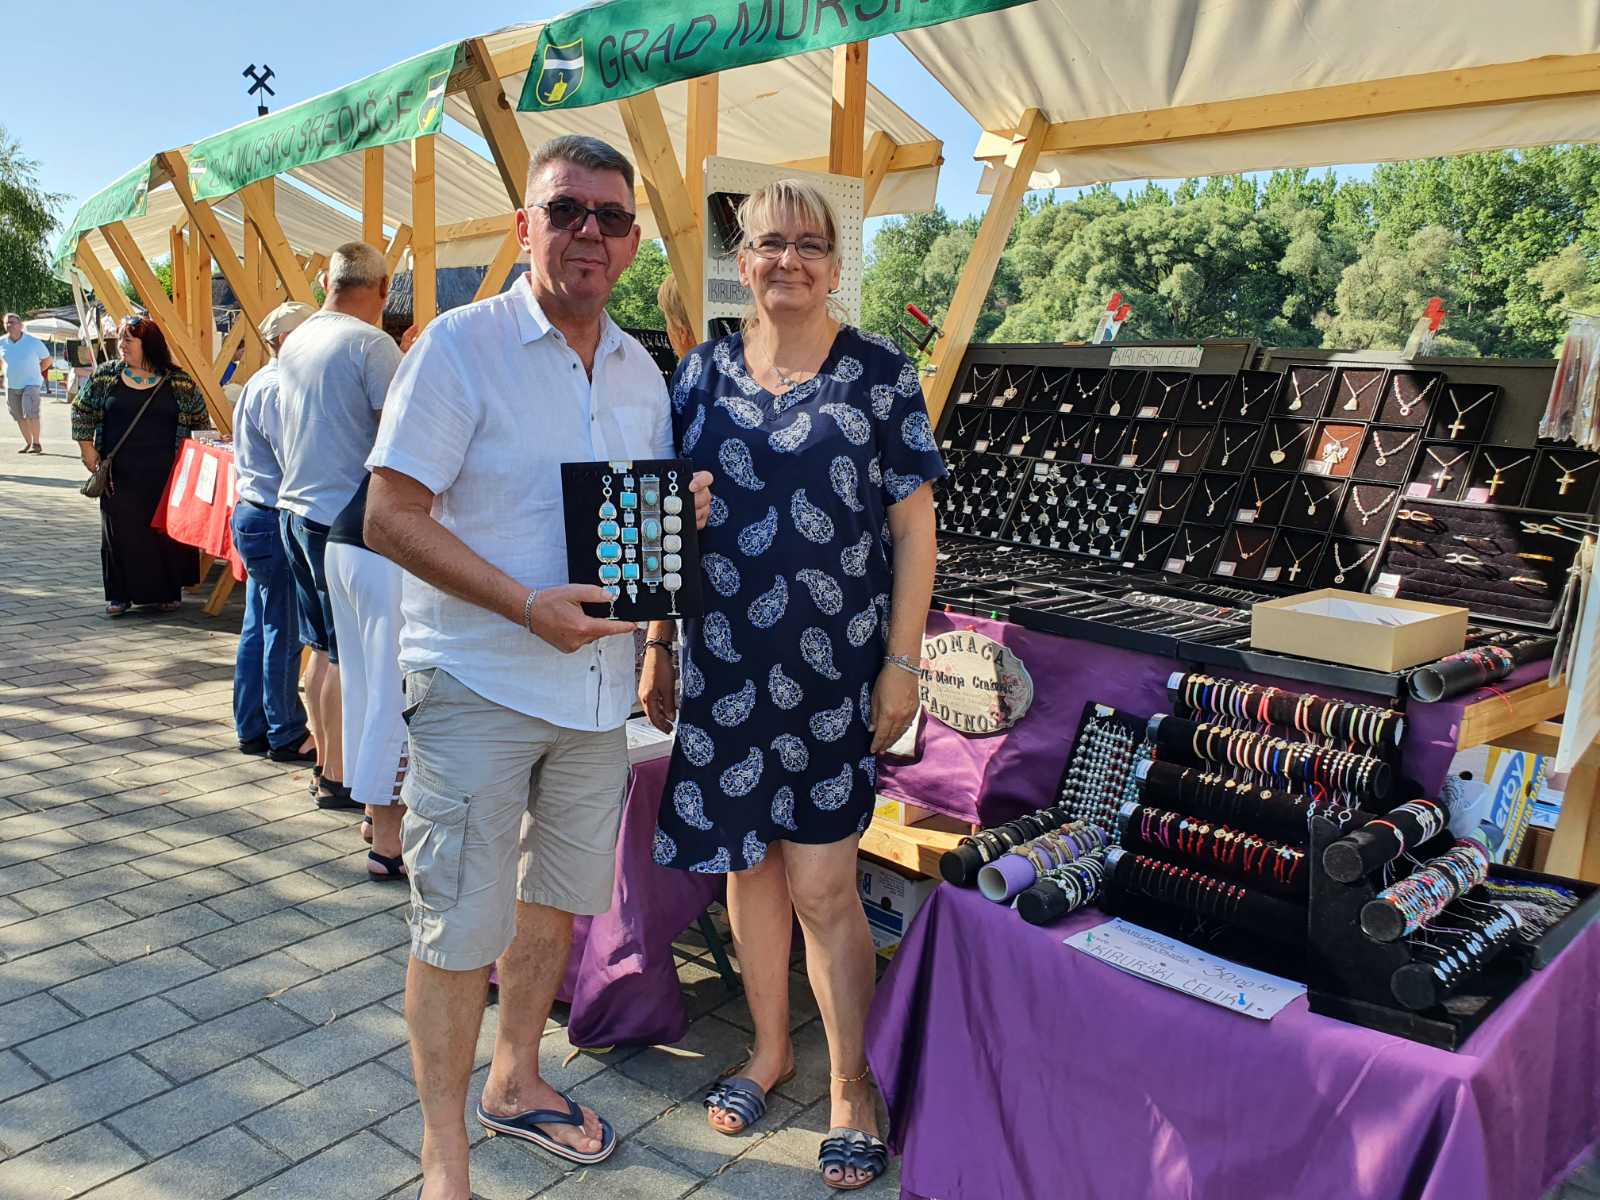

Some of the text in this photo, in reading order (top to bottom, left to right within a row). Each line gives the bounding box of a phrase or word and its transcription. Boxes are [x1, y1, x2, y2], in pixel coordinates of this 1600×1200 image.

[598, 0, 928, 88] GRAD MUR
[921, 686, 1003, 732] RADINOS
[1496, 758, 1522, 830] erby
